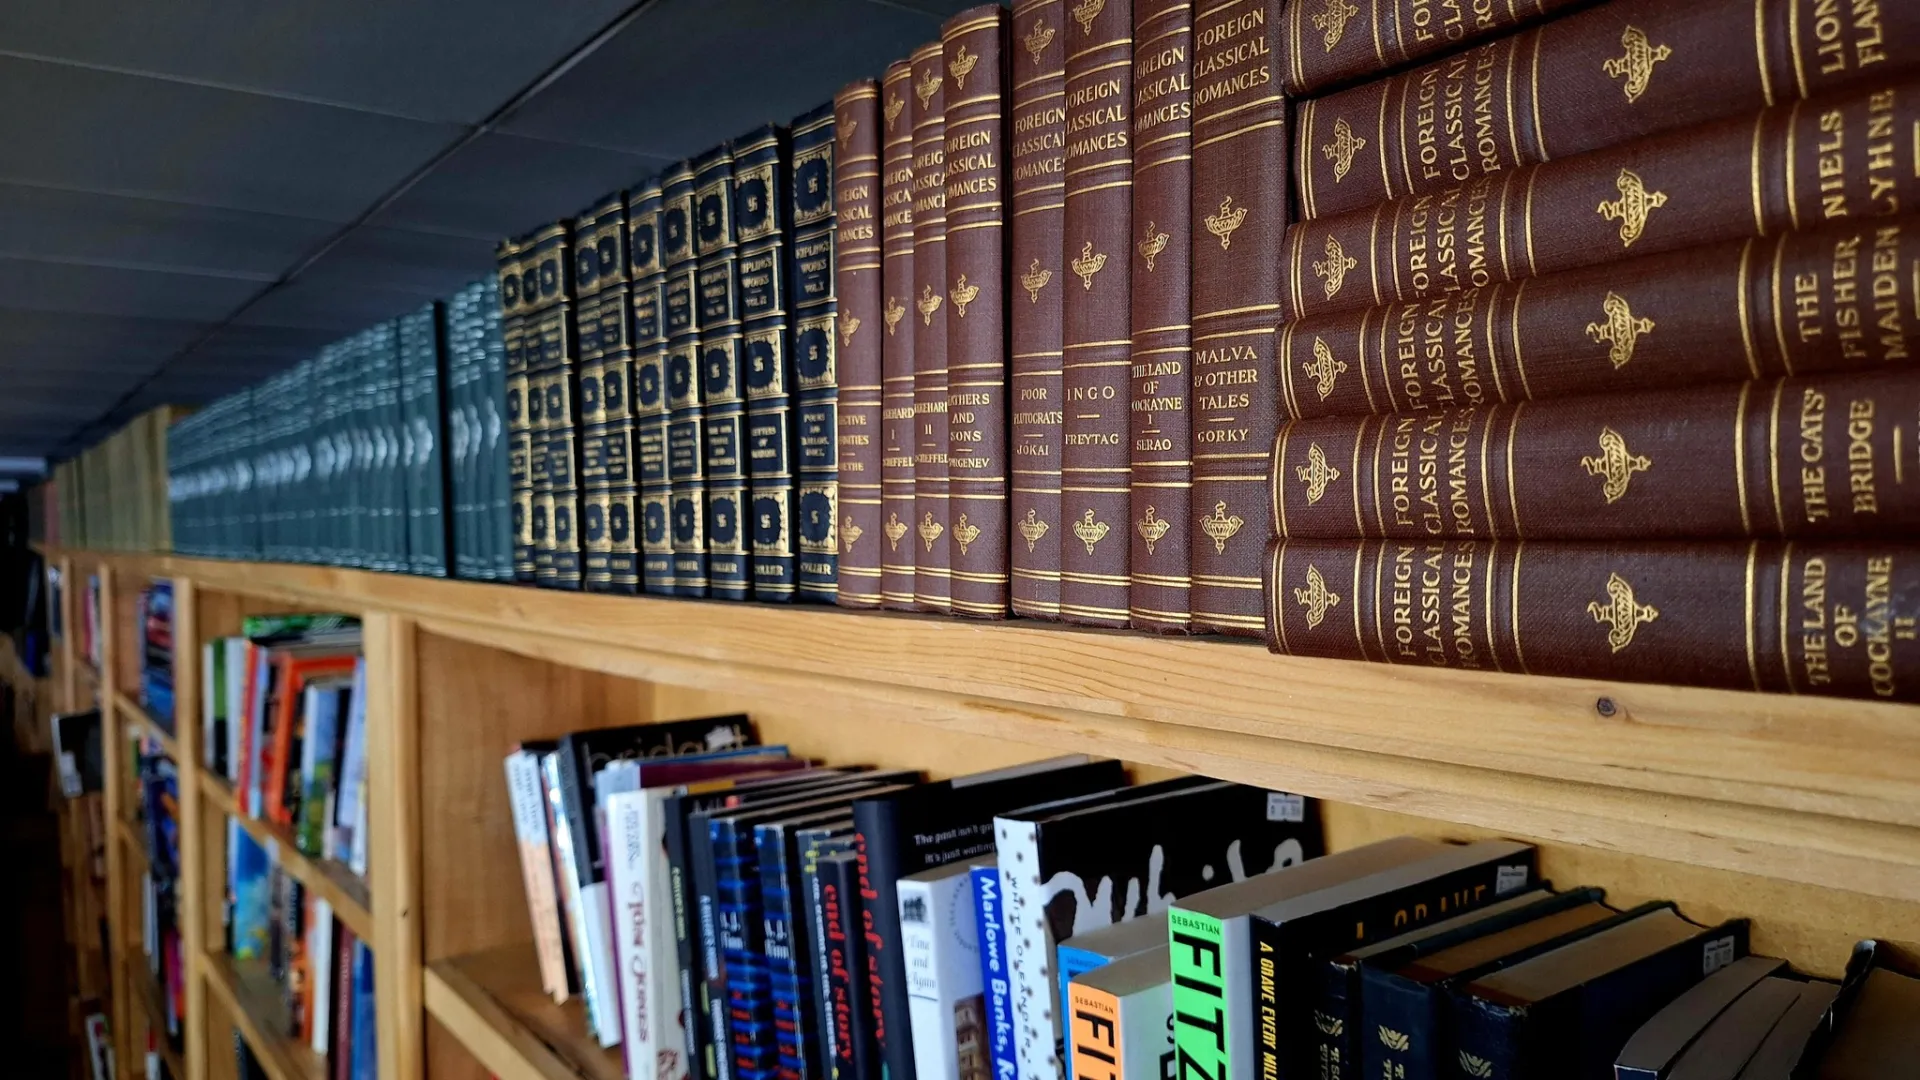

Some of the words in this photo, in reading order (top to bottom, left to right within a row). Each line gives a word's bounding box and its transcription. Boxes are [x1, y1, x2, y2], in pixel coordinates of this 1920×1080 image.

[1197, 8, 1264, 51] FOREIGN
[1134, 46, 1185, 83] OREIGN
[1194, 36, 1269, 79] CLASSICAL
[1135, 73, 1190, 108] ASSICAL
[1193, 67, 1269, 109] ROMANCES
[1015, 108, 1065, 134] FOREIGN
[1418, 68, 1440, 180] FOREIGN
[1013, 131, 1065, 158] CLASSICA
[1819, 109, 1848, 219] NIELS
[1410, 195, 1433, 298] OREIGN
[1795, 272, 1822, 342] THE
[1873, 227, 1908, 360] MAIDEN
[1148, 361, 1181, 376] LAND
[1196, 346, 1257, 365] MALVA
[1021, 388, 1047, 400] POOR
[1143, 381, 1159, 395] OF
[1194, 376, 1203, 387] &
[1206, 368, 1258, 385] OTHER
[952, 412, 975, 424] AND
[1014, 412, 1063, 425] PLUTOCRATS
[1132, 397, 1182, 412] COCKAYNE
[1199, 394, 1250, 410] TALES
[925, 424, 932, 435] II
[951, 430, 982, 442] SONS
[1016, 440, 1049, 455] JÓKAI
[1065, 434, 1119, 446] FREYTAG
[1136, 438, 1172, 451] SERAO
[1198, 429, 1249, 442] GORKY
[1392, 418, 1416, 526] FOREIGN
[1848, 399, 1877, 514] BRIDGE
[1801, 467, 1829, 523] THE
[1803, 558, 1826, 630] LAND
[1834, 605, 1858, 647] OF
[1865, 556, 1894, 696] COCKAYNE
[1803, 633, 1831, 686] THE
[824, 884, 846, 942] end
[862, 909, 884, 950] of
[980, 877, 1002, 973] Marlowe
[1171, 914, 1220, 936] SEBASTIAN
[1259, 941, 1274, 953] A
[831, 949, 850, 985] of
[1260, 957, 1275, 1004] GRAVE
[990, 978, 1012, 1053] Banks,
[1074, 996, 1114, 1015] SEBASTIAN
[835, 987, 853, 1063] story
[1261, 1005, 1276, 1050] EVERY
